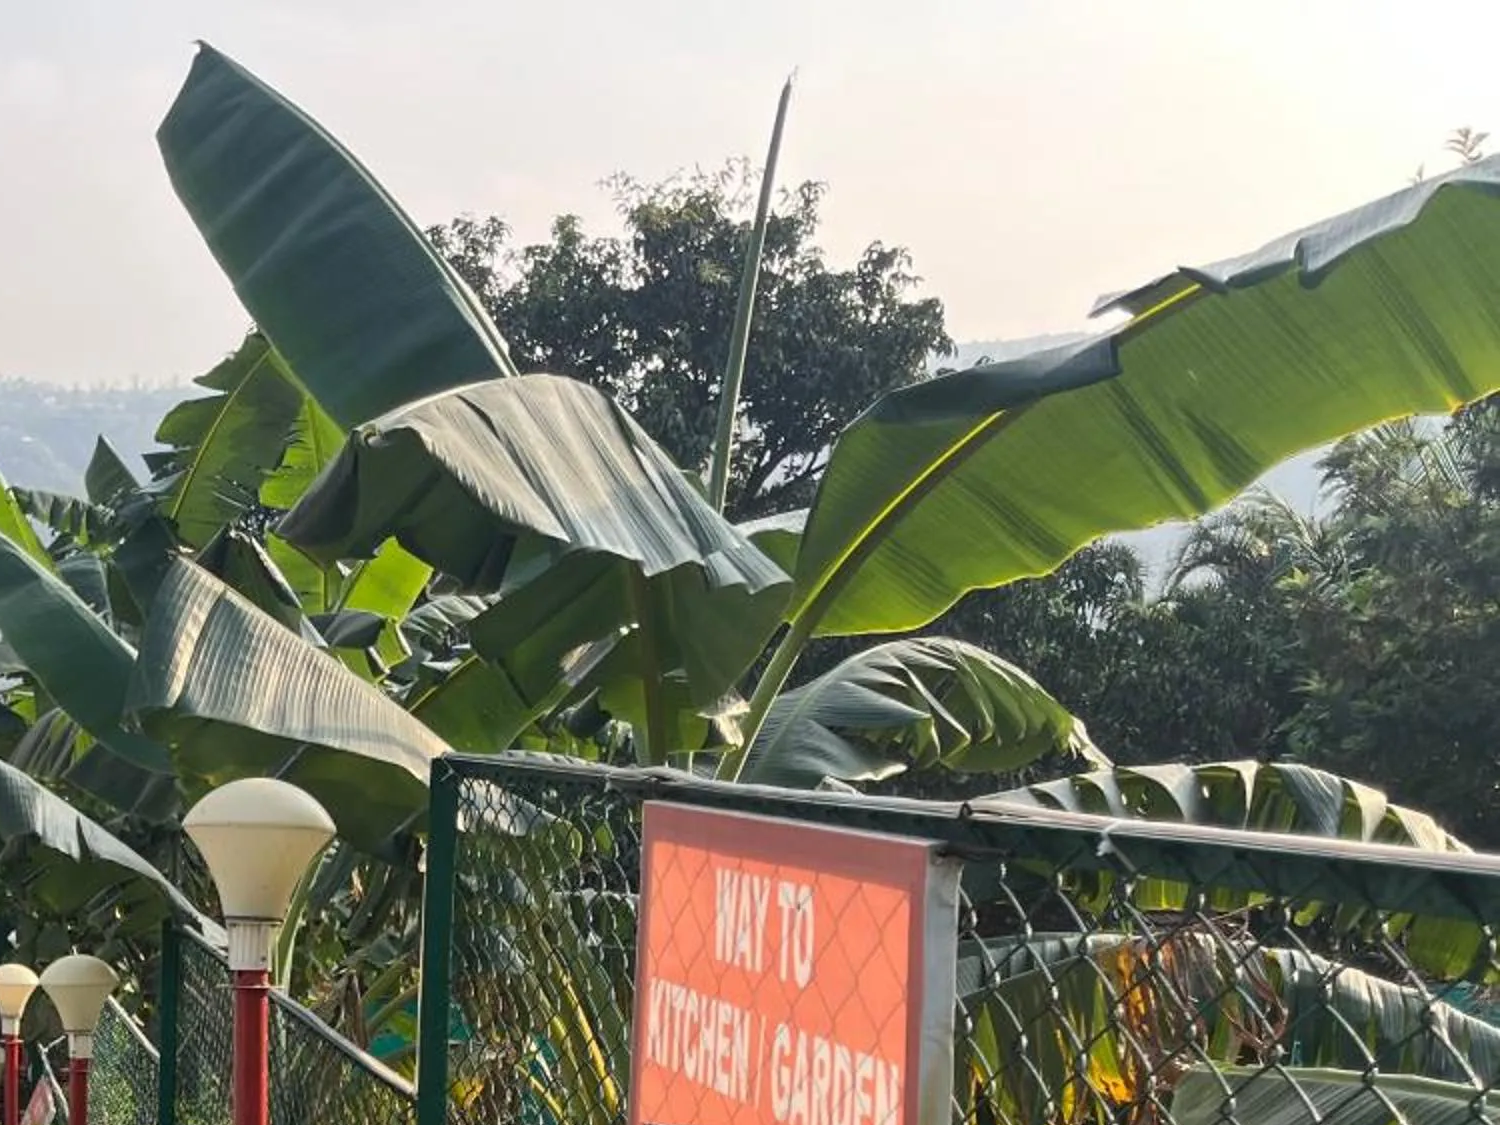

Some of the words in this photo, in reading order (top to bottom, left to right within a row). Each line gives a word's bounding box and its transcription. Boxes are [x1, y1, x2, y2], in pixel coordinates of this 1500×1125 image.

[715, 868, 768, 972] WAY
[778, 881, 814, 988] TO
[647, 977, 750, 1102] KITCHEN
